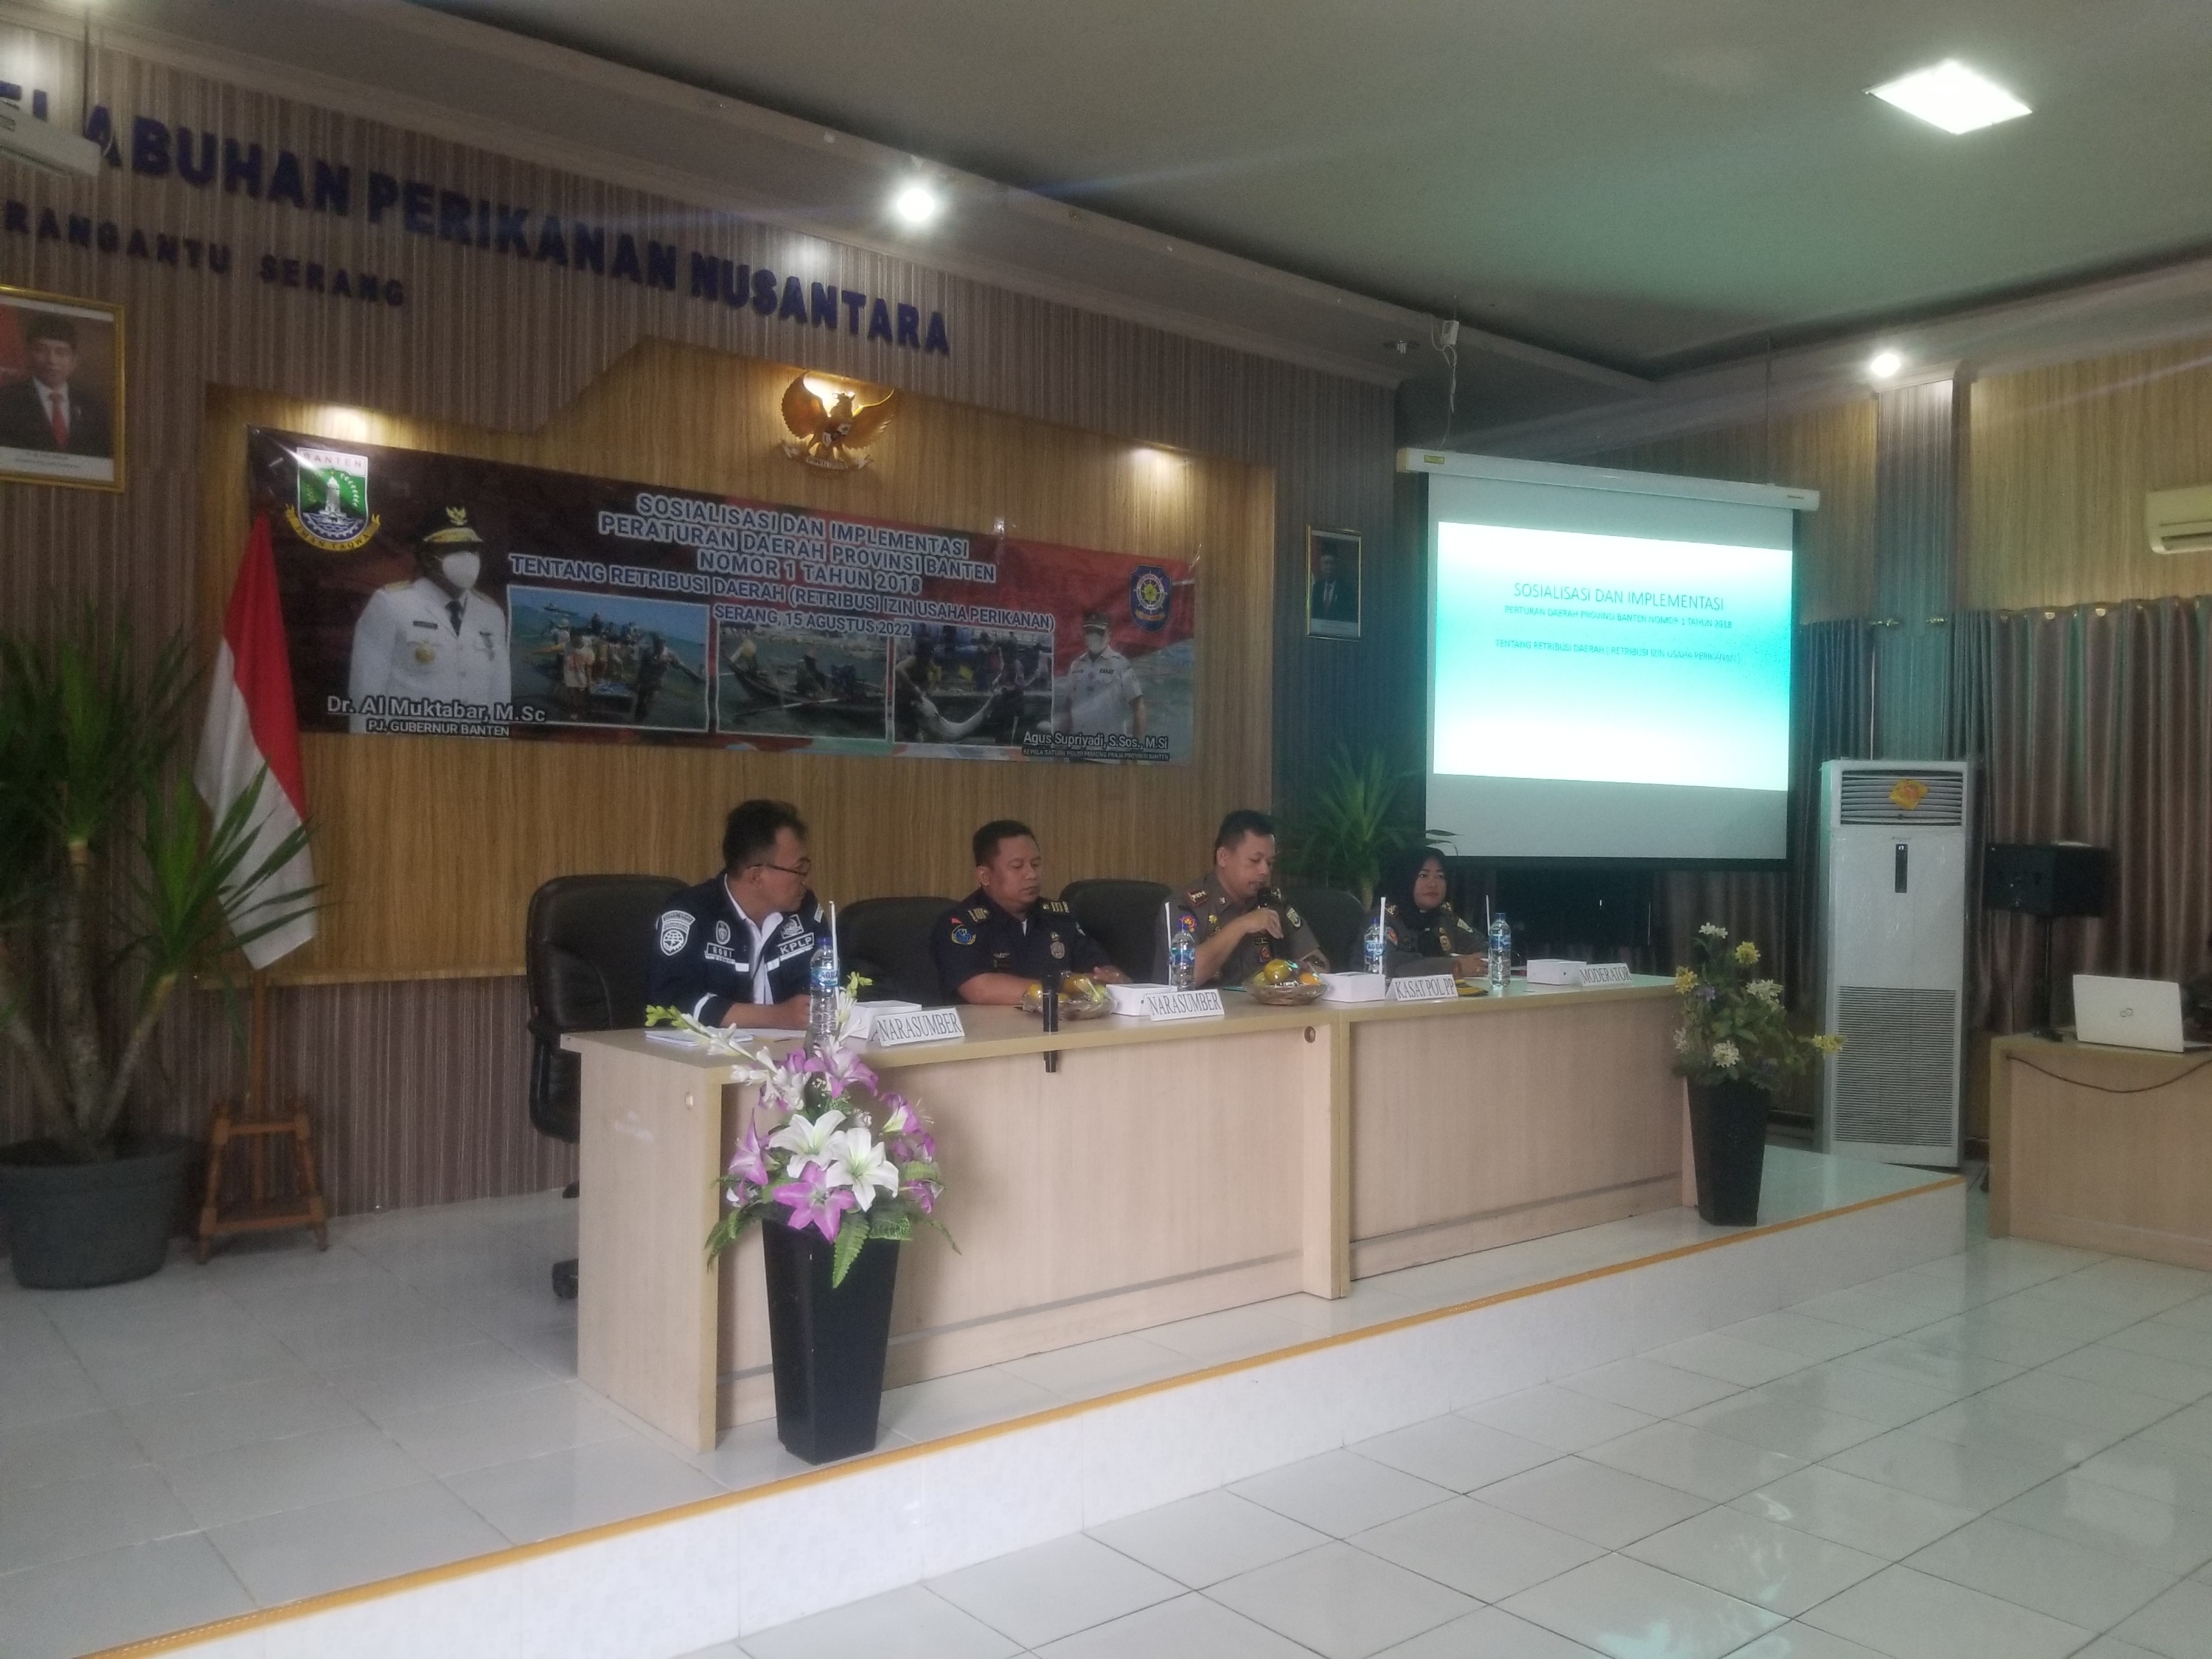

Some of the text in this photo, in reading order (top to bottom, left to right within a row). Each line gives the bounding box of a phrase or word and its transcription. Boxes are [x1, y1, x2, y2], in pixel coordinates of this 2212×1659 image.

[0, 80, 950, 357] ABUHAN PERIKANAN NUSANTARA
[260, 253, 404, 307] SERANG
[304, 452, 362, 467] BANTEN
[638, 495, 968, 557] SOSIALISASI DAN IMPLEMENTASI
[600, 514, 995, 581] PERATURAN DAERAH PROVINSI BANTEN
[699, 550, 921, 594] NOMOR 1 TAHUN 2018
[511, 555, 1055, 632] TENTANG RETRIBUSI DAERAH (RETRIBUSI IZIN USAHA PERIKANAN)
[1514, 582, 1724, 611] SOSIALISASI DAN IMPLEMENTASI
[714, 604, 911, 637] SERANG, 15 AGUSTUS 2022
[1548, 608, 1579, 618] DAERAH
[1581, 611, 1615, 621] PROVINSI
[1617, 613, 1647, 622] BANTEN
[1649, 616, 1679, 625] NOMOR
[1688, 617, 1713, 627] TAHUN
[1495, 639, 1531, 650] TENTANG
[1534, 641, 1572, 652] RETRIBUSI
[1573, 644, 1604, 654] DAERAH
[327, 696, 546, 723] Dr. Al Muktabar, M.Sc
[368, 720, 509, 737] PJ. GUBERNUR BANTEN
[1023, 731, 1051, 748] Agus
[1054, 732, 1107, 748] Supriyadi,
[1145, 736, 1168, 750] M.Si
[779, 936, 812, 955] KPLP
[1394, 978, 1455, 999] KASAT POL PP
[1579, 966, 1632, 984] MODERATOR
[1147, 991, 1222, 1016] NARASUMBER
[876, 1012, 962, 1042] NARASUMBER
